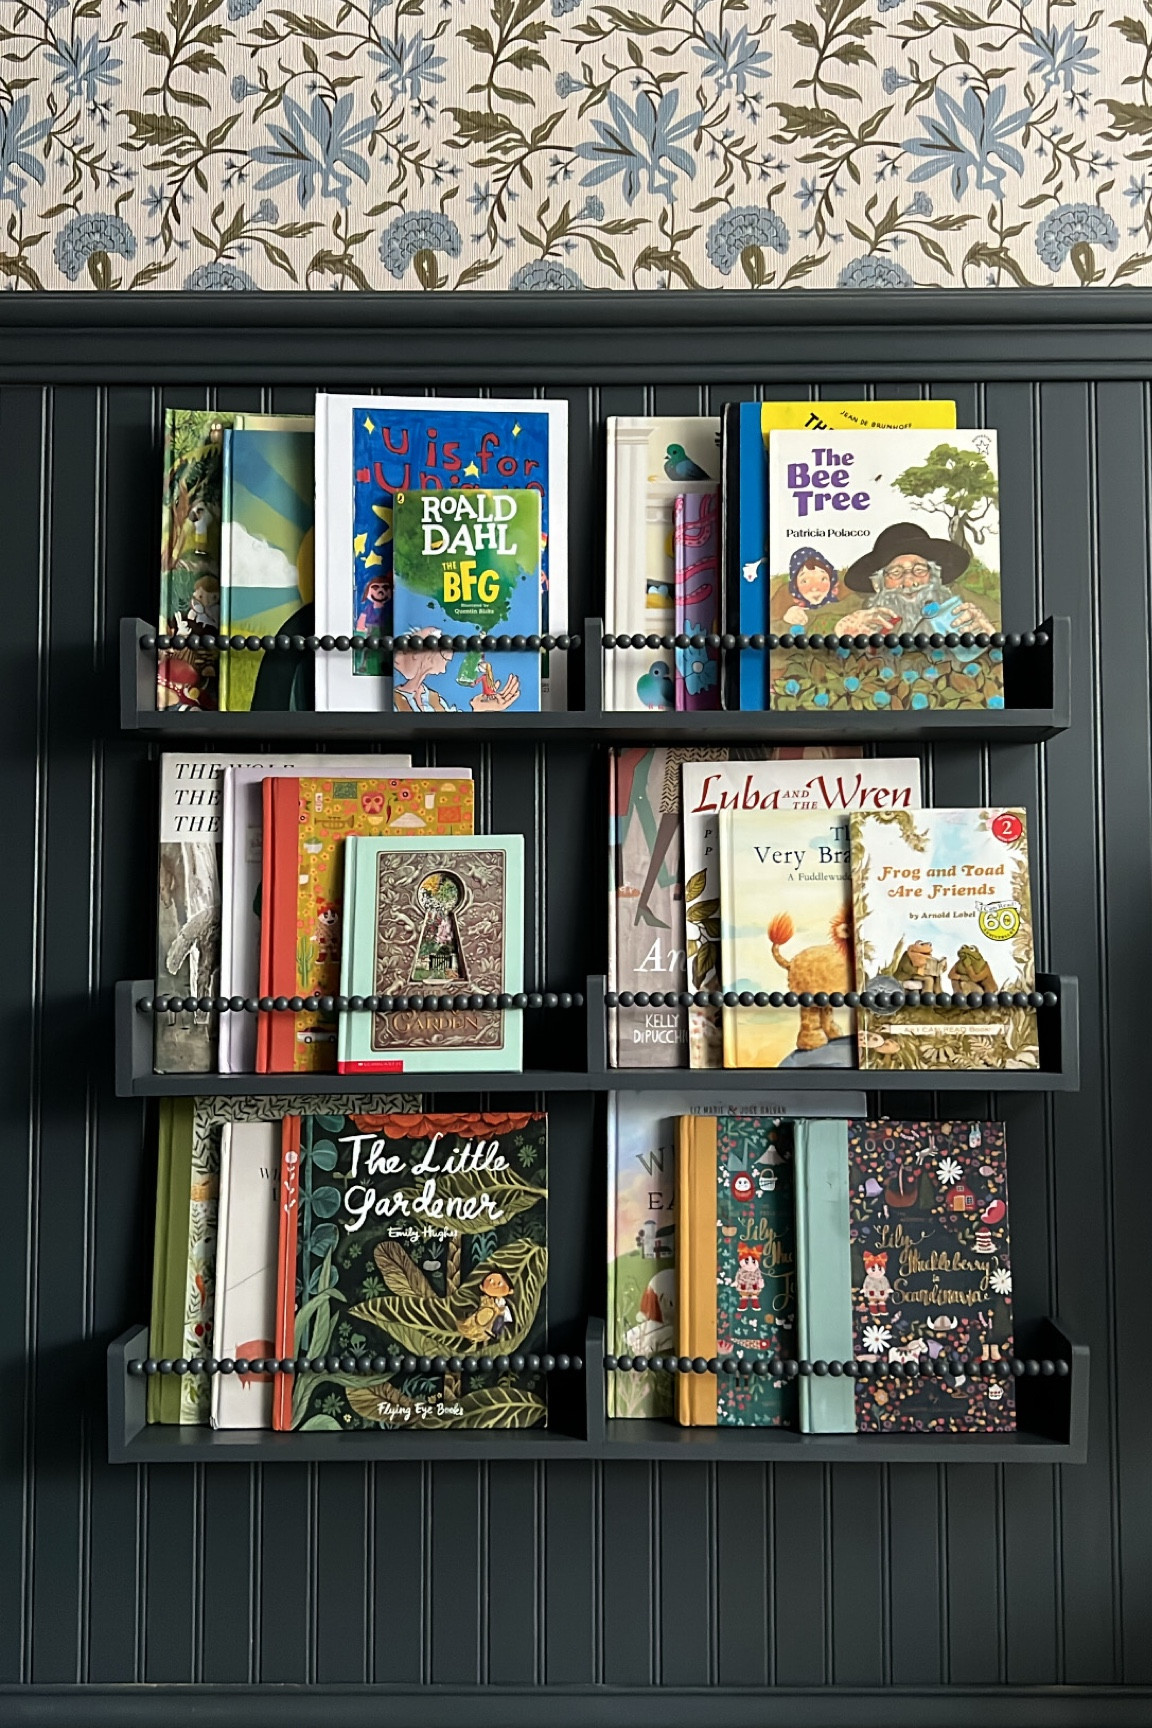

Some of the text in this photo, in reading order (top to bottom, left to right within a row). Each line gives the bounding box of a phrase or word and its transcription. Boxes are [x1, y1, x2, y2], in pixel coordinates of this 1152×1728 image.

[804, 412, 834, 430] TH
[840, 410, 858, 423] JEAN
[871, 421, 912, 430] BRUNHOFF
[426, 428, 462, 471] is
[476, 432, 539, 477] for
[811, 448, 854, 466] The
[787, 462, 850, 488] Bee
[421, 494, 517, 523] ROALD
[792, 491, 871, 517] Tree
[422, 523, 517, 556] DAHL
[786, 528, 871, 538] Patricia Polacco
[442, 561, 456, 571] THE
[443, 560, 500, 603] BFG
[175, 764, 221, 779] THE
[174, 790, 220, 805] THE
[691, 773, 912, 813] Luba AND THE Wren
[174, 816, 220, 832] THE
[1001, 820, 1013, 835] 2
[754, 846, 806, 871] Very
[788, 873, 794, 881] A
[877, 864, 1005, 881] Frog and Toad
[888, 883, 996, 899] Are Friends
[909, 910, 976, 920] by Arnold Lobel
[984, 910, 1016, 930] 60
[392, 1009, 480, 1032] GARDEN
[645, 1013, 680, 1028] KELLY
[338, 1132, 510, 1178] The Little
[344, 1178, 505, 1233] Gardener
[386, 1225, 458, 1242] Emily Hughes
[738, 1217, 780, 1257] Lily
[874, 1223, 918, 1264] Lily
[899, 1248, 999, 1291] Huckleberry
[891, 1278, 990, 1307] Scandinavia
[377, 1401, 464, 1421] Flying Eye Books
